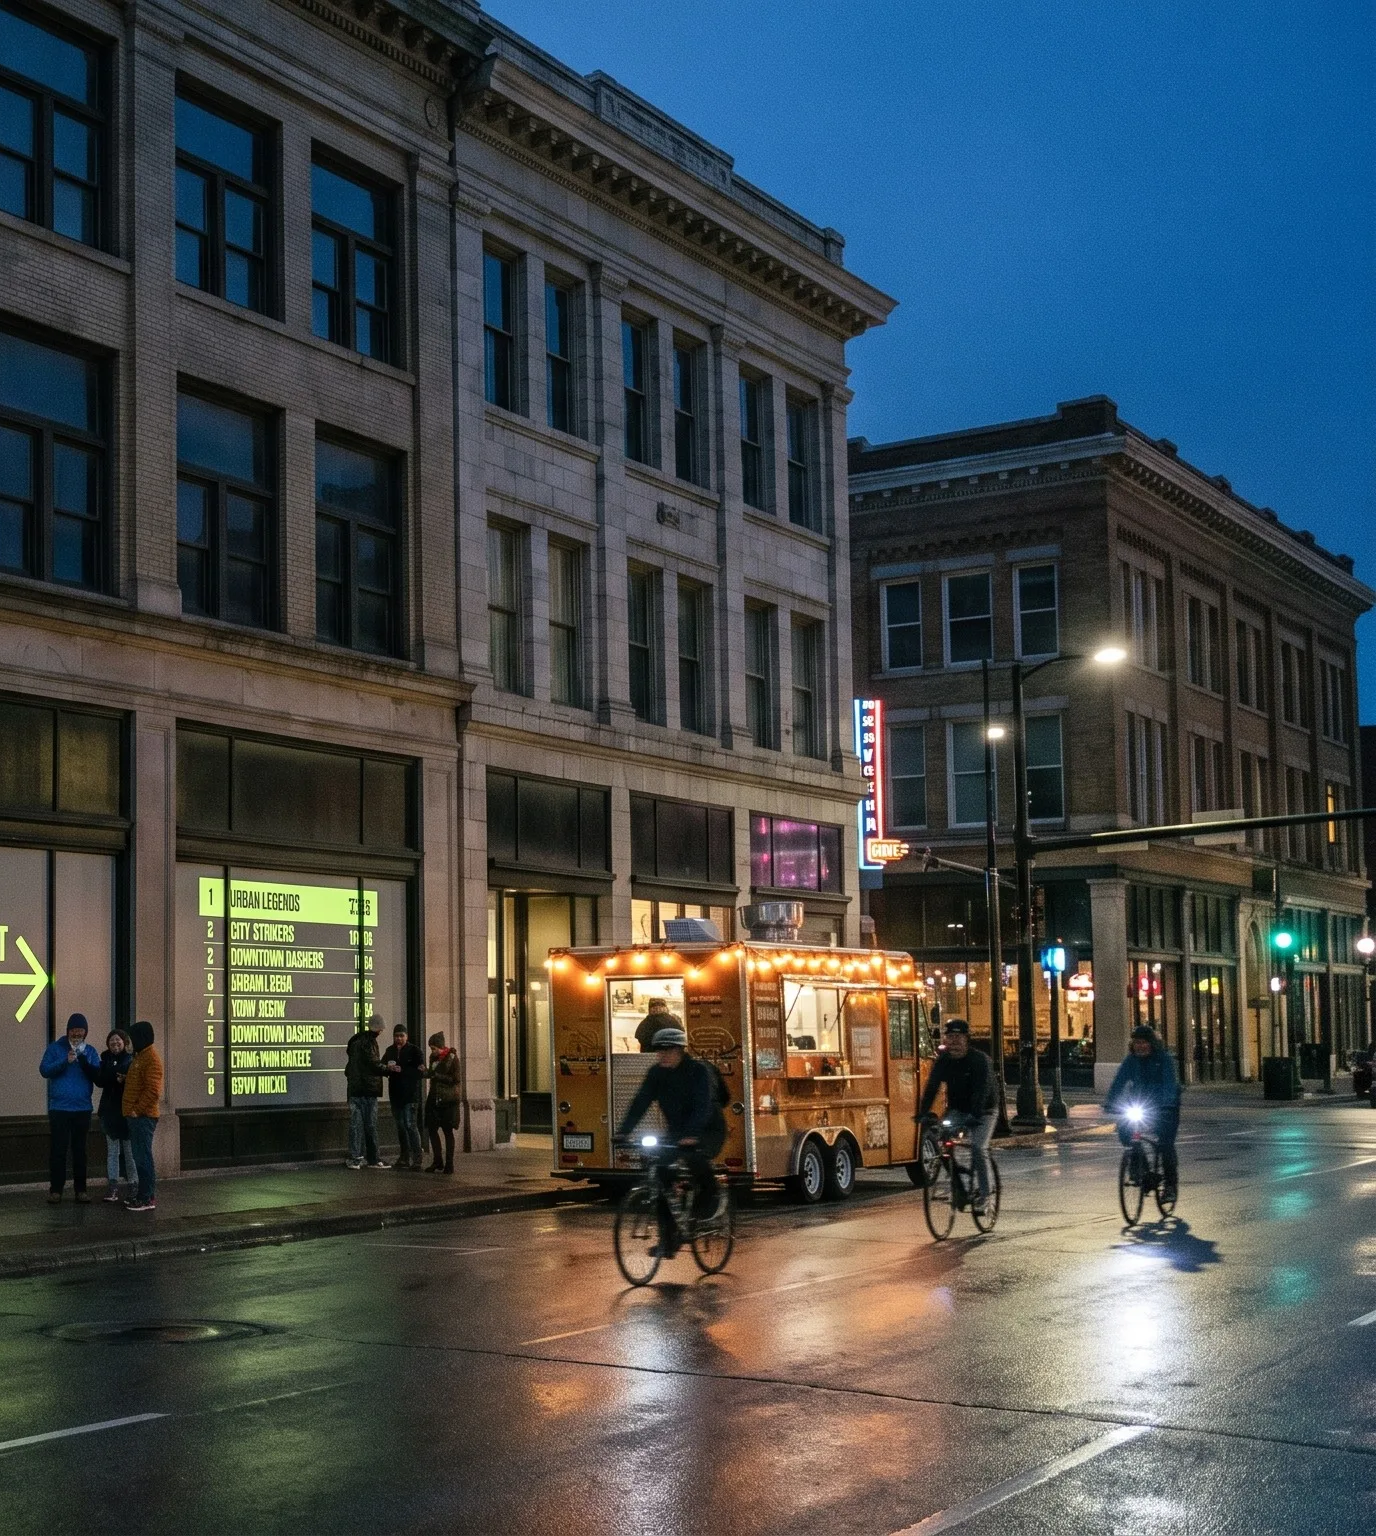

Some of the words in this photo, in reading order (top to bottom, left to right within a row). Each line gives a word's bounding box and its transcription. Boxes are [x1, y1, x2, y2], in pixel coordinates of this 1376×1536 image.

[208, 888, 214, 906] 1
[229, 888, 261, 911] URBAN
[262, 890, 301, 912] LEGENDS
[207, 920, 214, 939] 2
[230, 921, 251, 941] CITY
[253, 922, 295, 943] STRIKERS
[207, 947, 214, 965] 2
[230, 947, 285, 968] DOWNTOWN
[285, 950, 324, 969] DASHERS
[207, 972, 214, 991] 3
[207, 999, 214, 1017] 4
[207, 1025, 214, 1043] 5
[286, 1024, 325, 1043] DASHERS
